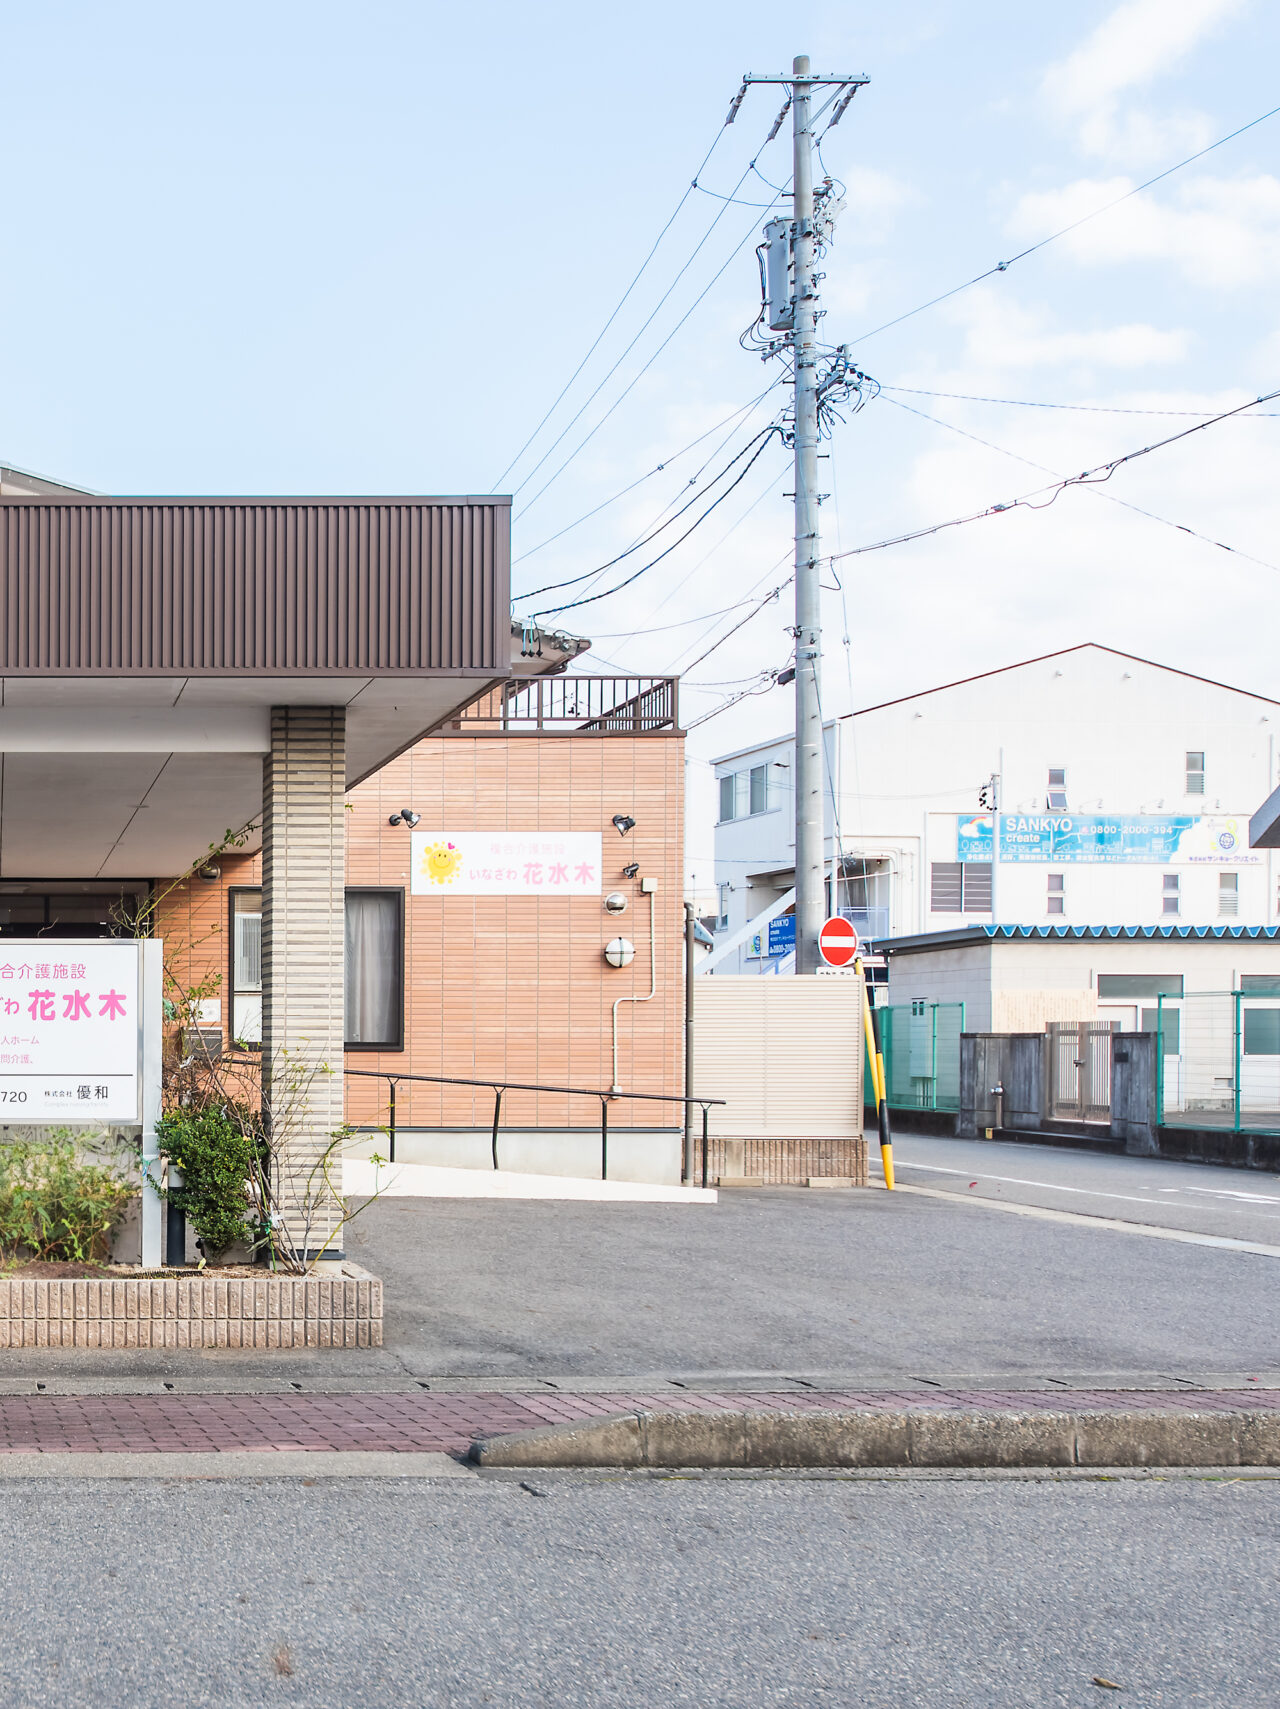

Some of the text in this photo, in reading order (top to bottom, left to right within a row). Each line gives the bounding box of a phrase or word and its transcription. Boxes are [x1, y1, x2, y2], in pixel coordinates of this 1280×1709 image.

[1006, 817, 1073, 832] SANKYO
[1006, 833, 1040, 843] create
[470, 862, 595, 885] いなざわ 花水木
[27, 989, 127, 1021] 花水木
[44, 1085, 109, 1100] 株式会社 優和
